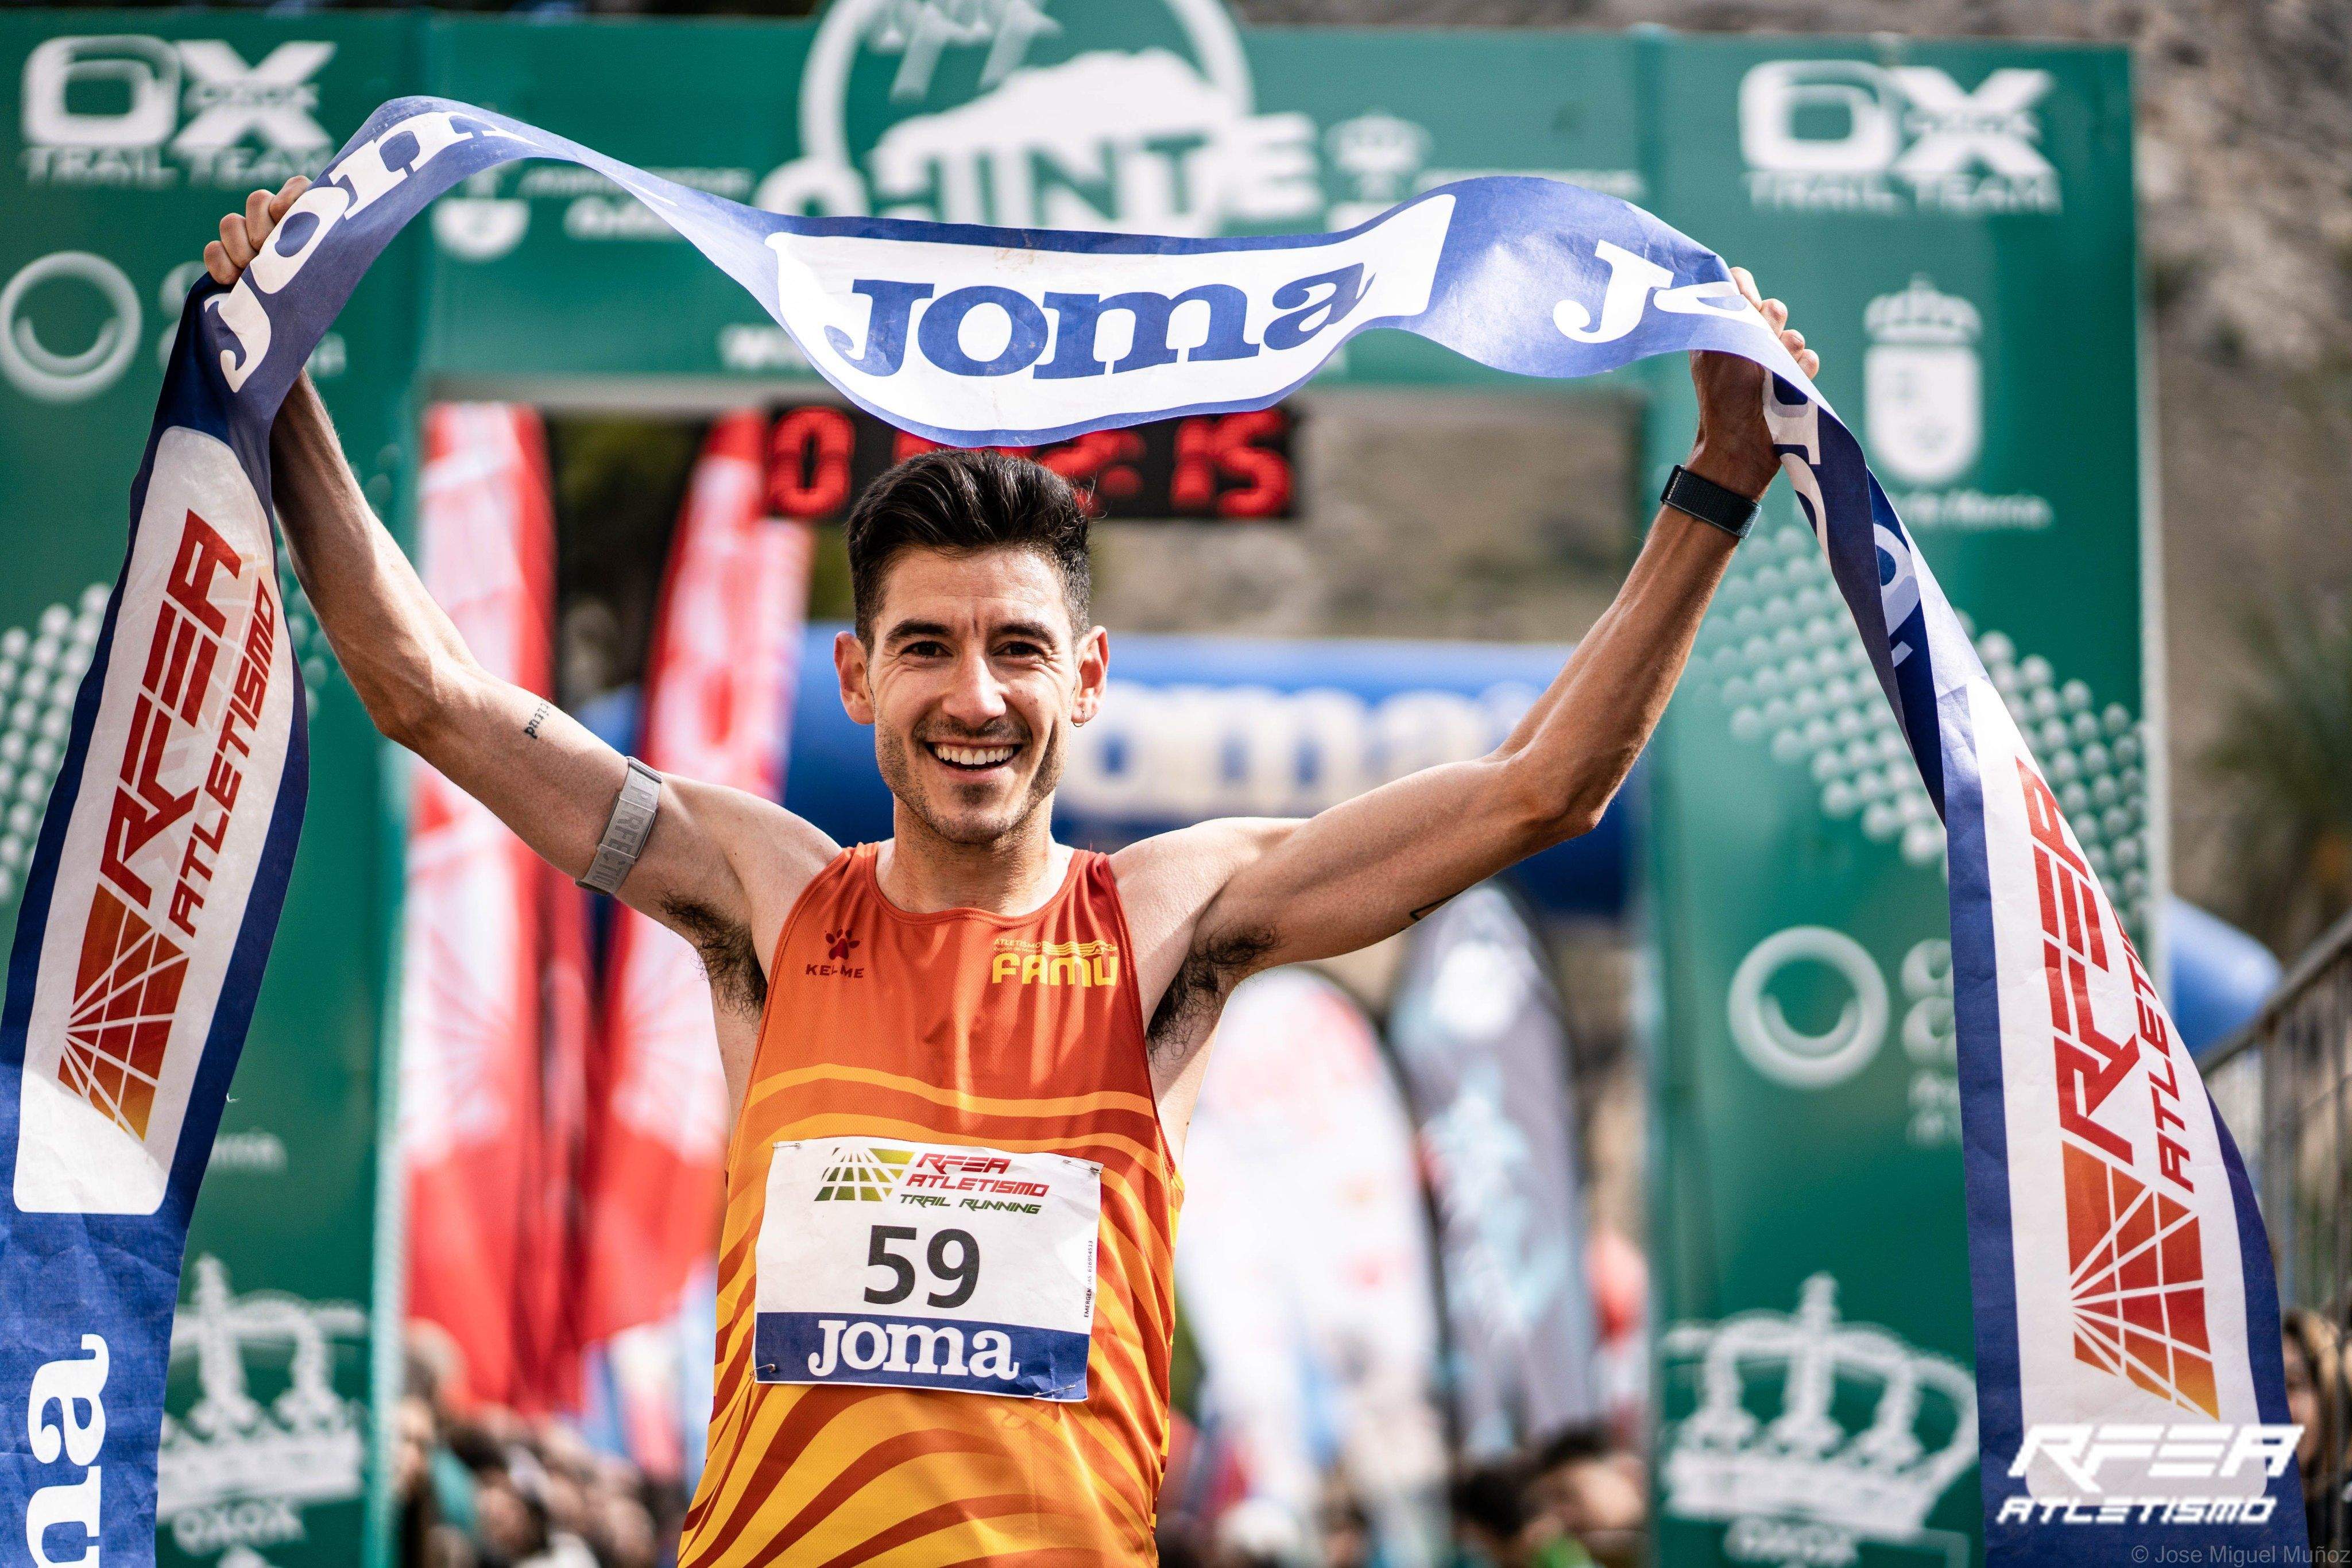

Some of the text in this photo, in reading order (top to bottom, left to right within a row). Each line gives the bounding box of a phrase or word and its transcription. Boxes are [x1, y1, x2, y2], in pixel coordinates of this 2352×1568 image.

[99, 508, 242, 909] RFEA
[168, 576, 275, 938] ATLETISMO
[992, 953, 1118, 987] FAMU
[2015, 756, 2140, 1166] RFEA
[906, 1174, 1050, 1197] ATLETISMO
[916, 1153, 1011, 1175] RFEA
[900, 1194, 1042, 1215] TRAIL RUNNING
[864, 1225, 980, 1308] 59
[808, 1320, 1019, 1380] Joma
